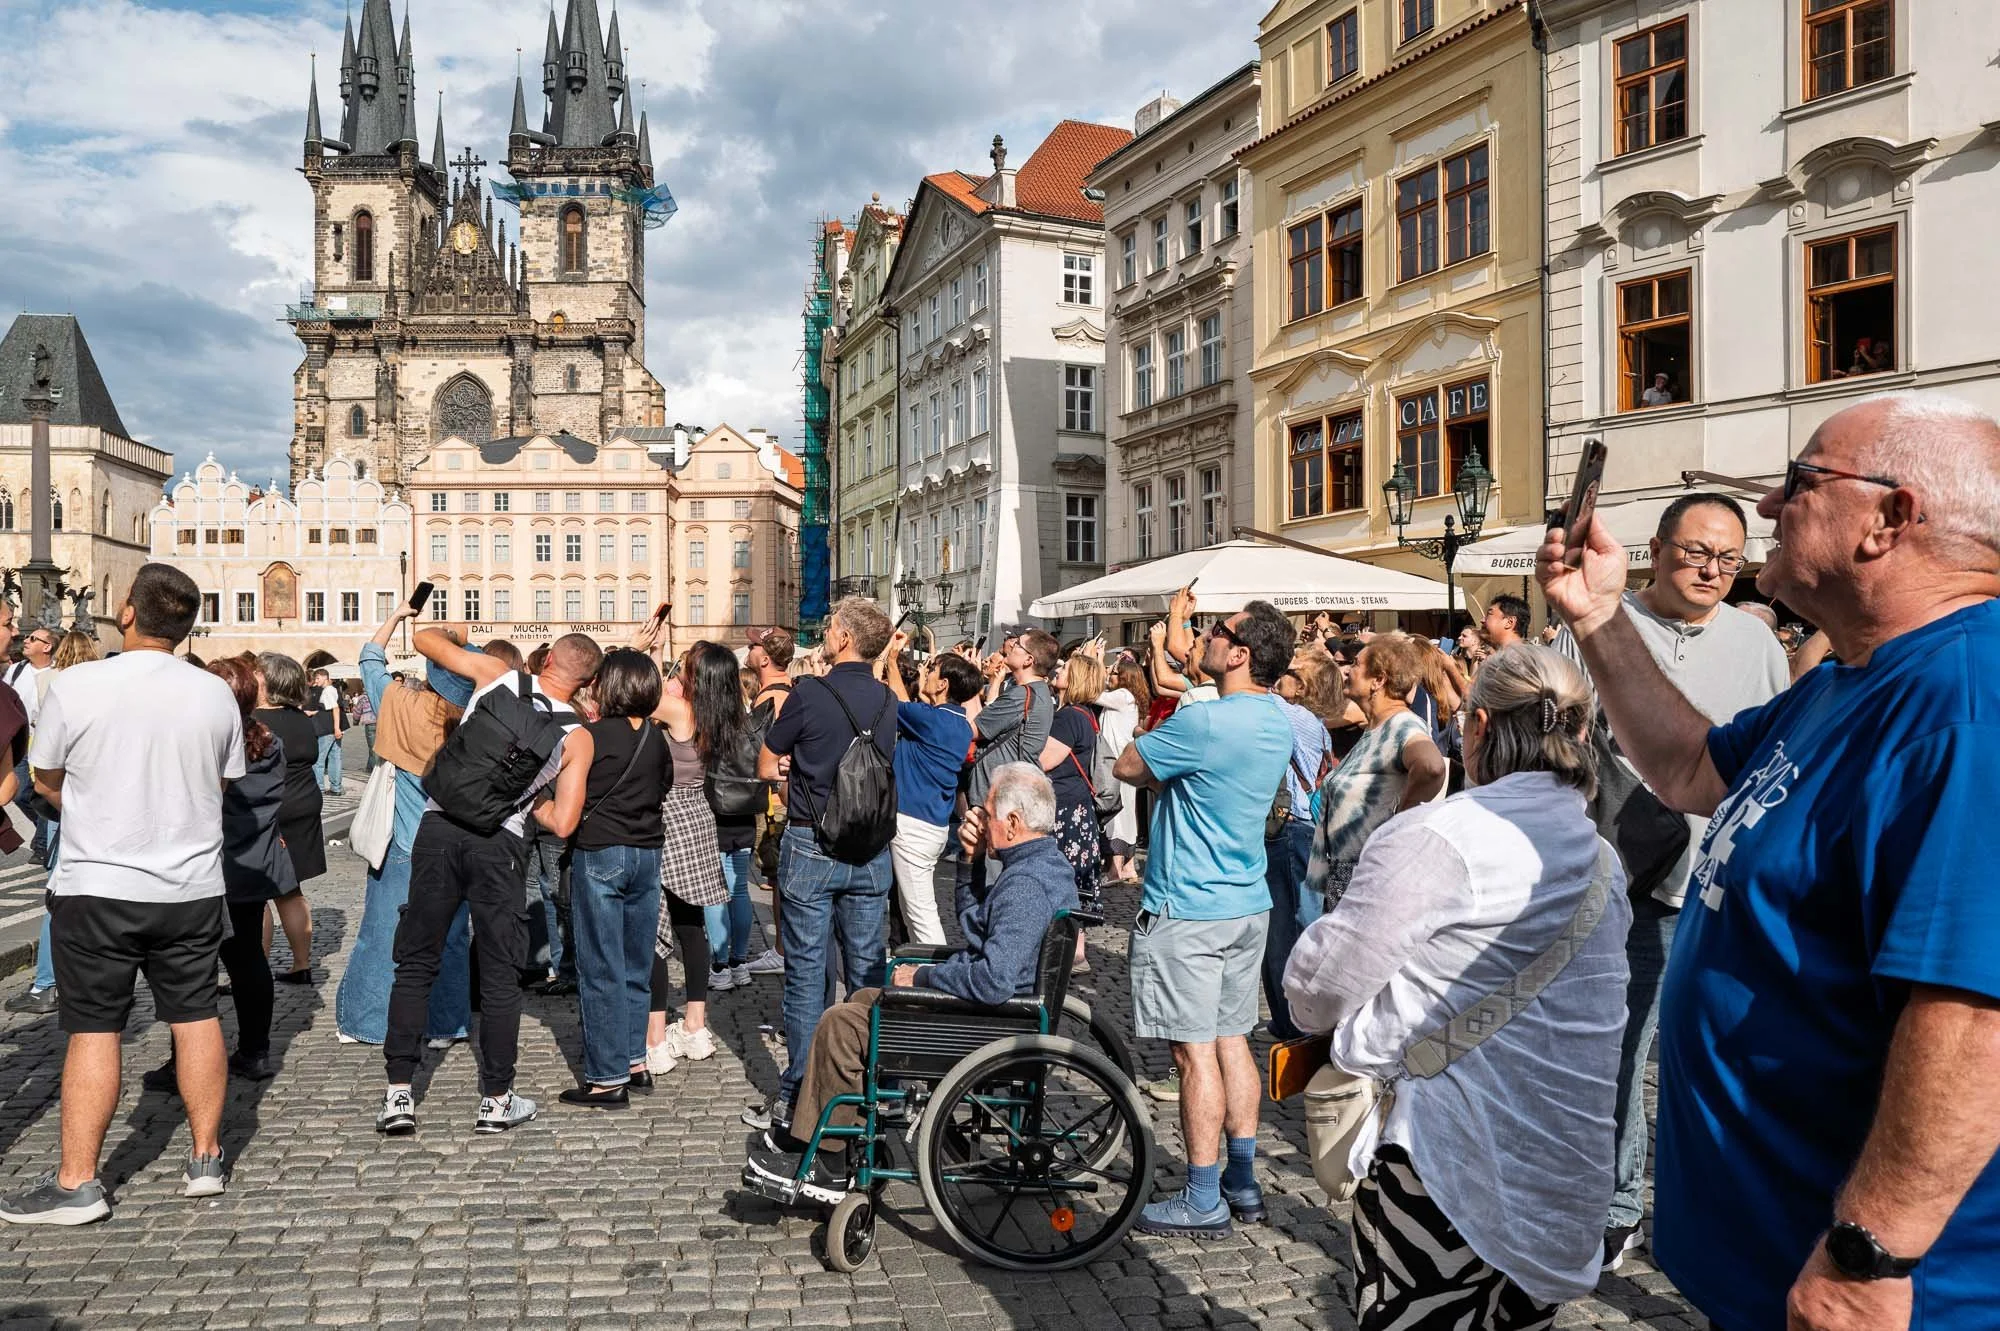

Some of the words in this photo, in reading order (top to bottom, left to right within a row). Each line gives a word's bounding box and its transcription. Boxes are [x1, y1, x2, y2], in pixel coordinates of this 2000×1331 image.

[1402, 384, 1487, 425] CAFE
[984, 504, 996, 588] HOTEL
[1274, 597, 1309, 606] BURGERS
[1315, 596, 1355, 605] COCKTAILS
[1361, 596, 1389, 605] STEAKS
[471, 625, 493, 633] DALI
[513, 624, 549, 633] MUCHA
[570, 624, 611, 633] WARHOL
